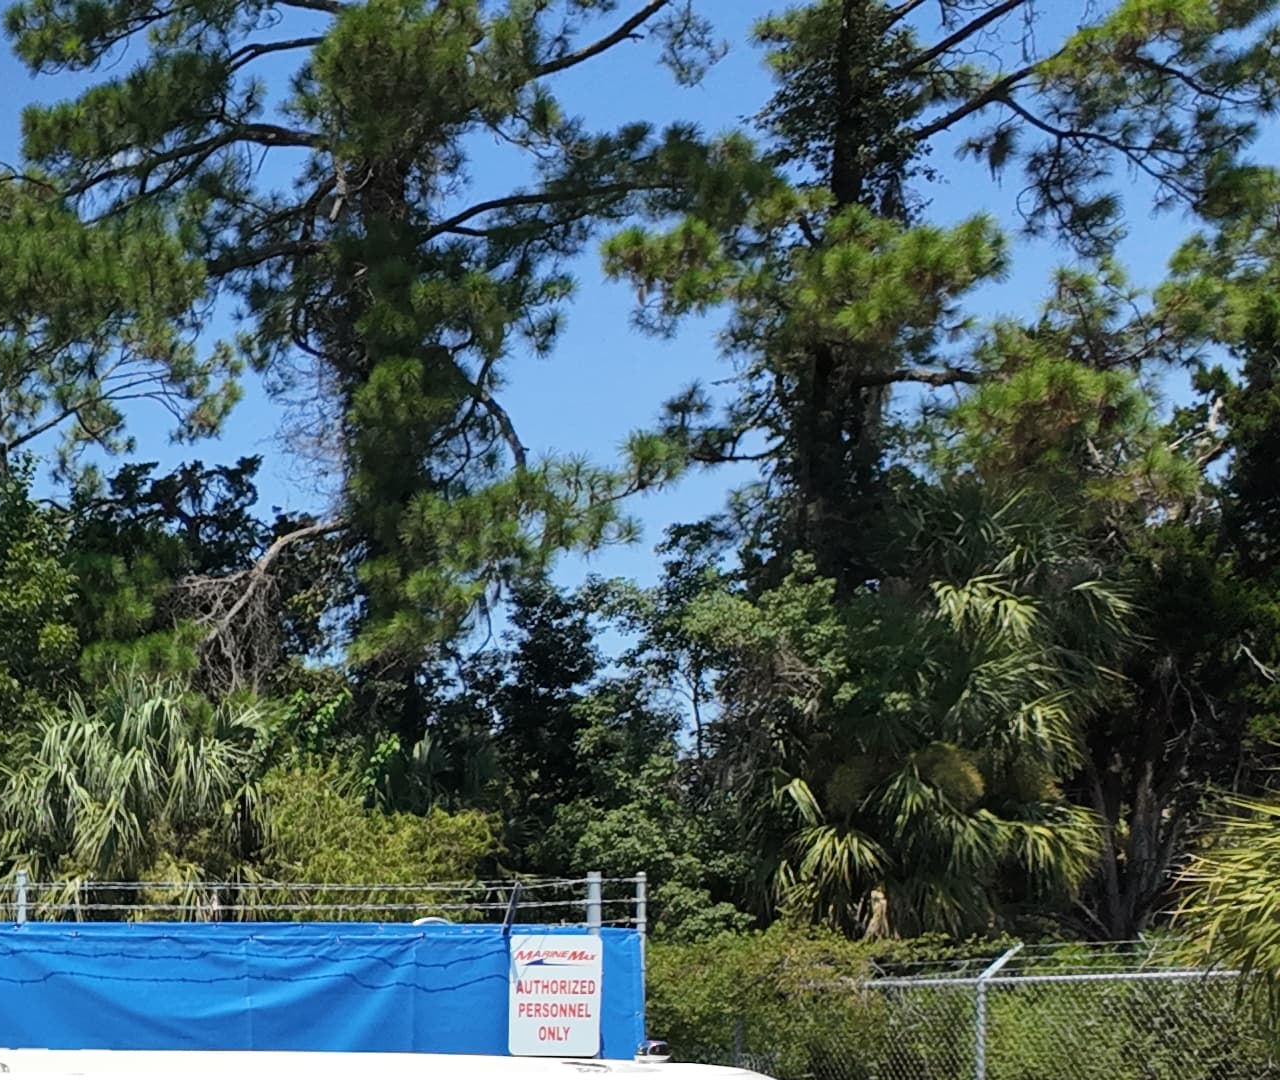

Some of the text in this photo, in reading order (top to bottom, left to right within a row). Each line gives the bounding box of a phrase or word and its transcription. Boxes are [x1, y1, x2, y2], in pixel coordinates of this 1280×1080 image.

[516, 980, 596, 995] AUTHORIZED
[519, 1003, 592, 1018] PERSONNEL
[538, 1027, 571, 1041] ONLY
